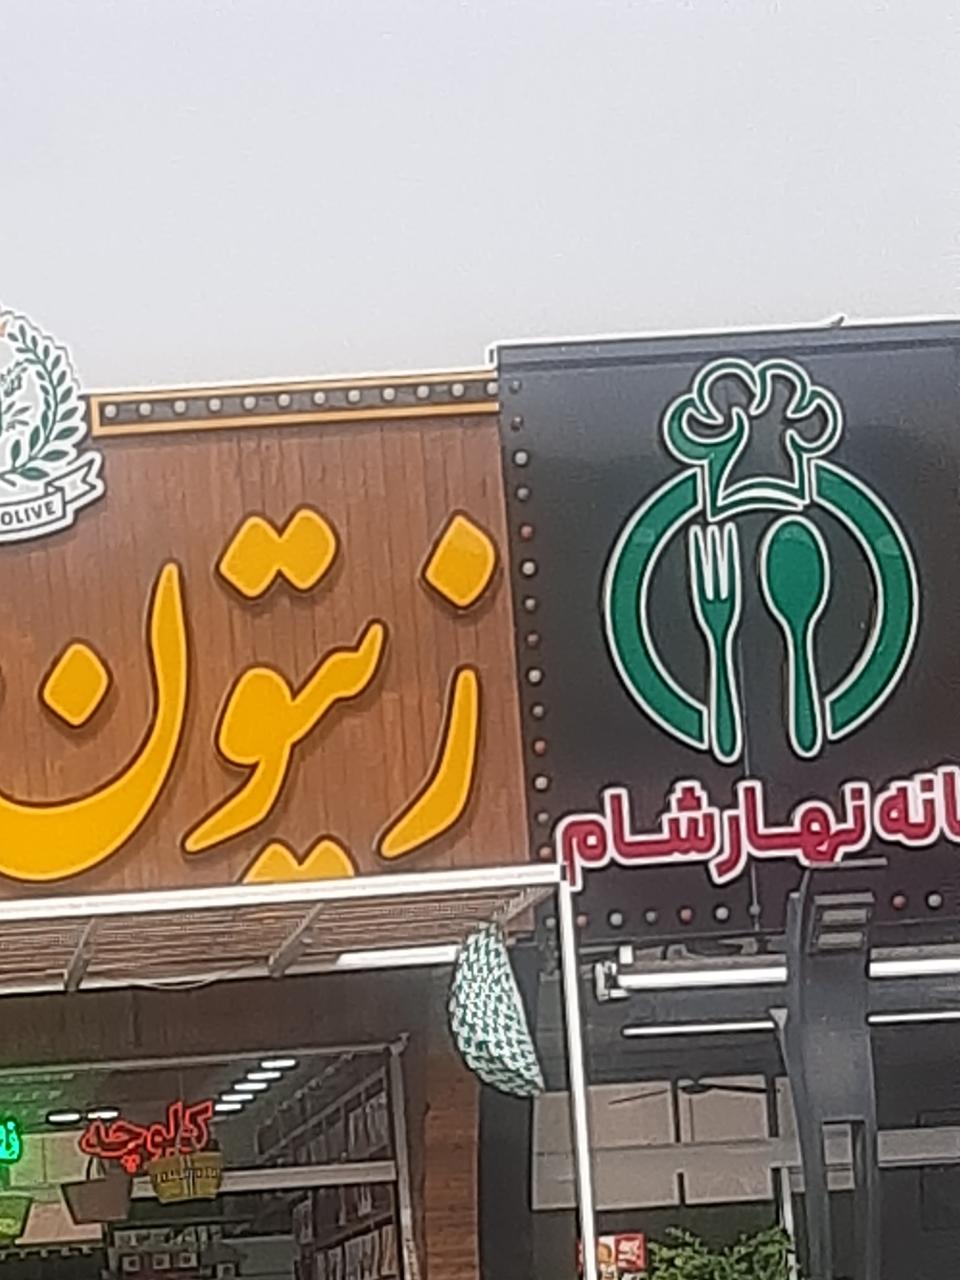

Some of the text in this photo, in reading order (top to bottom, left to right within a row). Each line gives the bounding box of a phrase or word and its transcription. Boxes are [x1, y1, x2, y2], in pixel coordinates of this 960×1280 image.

[0, 500, 57, 526] OLIVE
[554, 765, 960, 892] انه نهار شام
[81, 1101, 214, 1174] کلوچه
